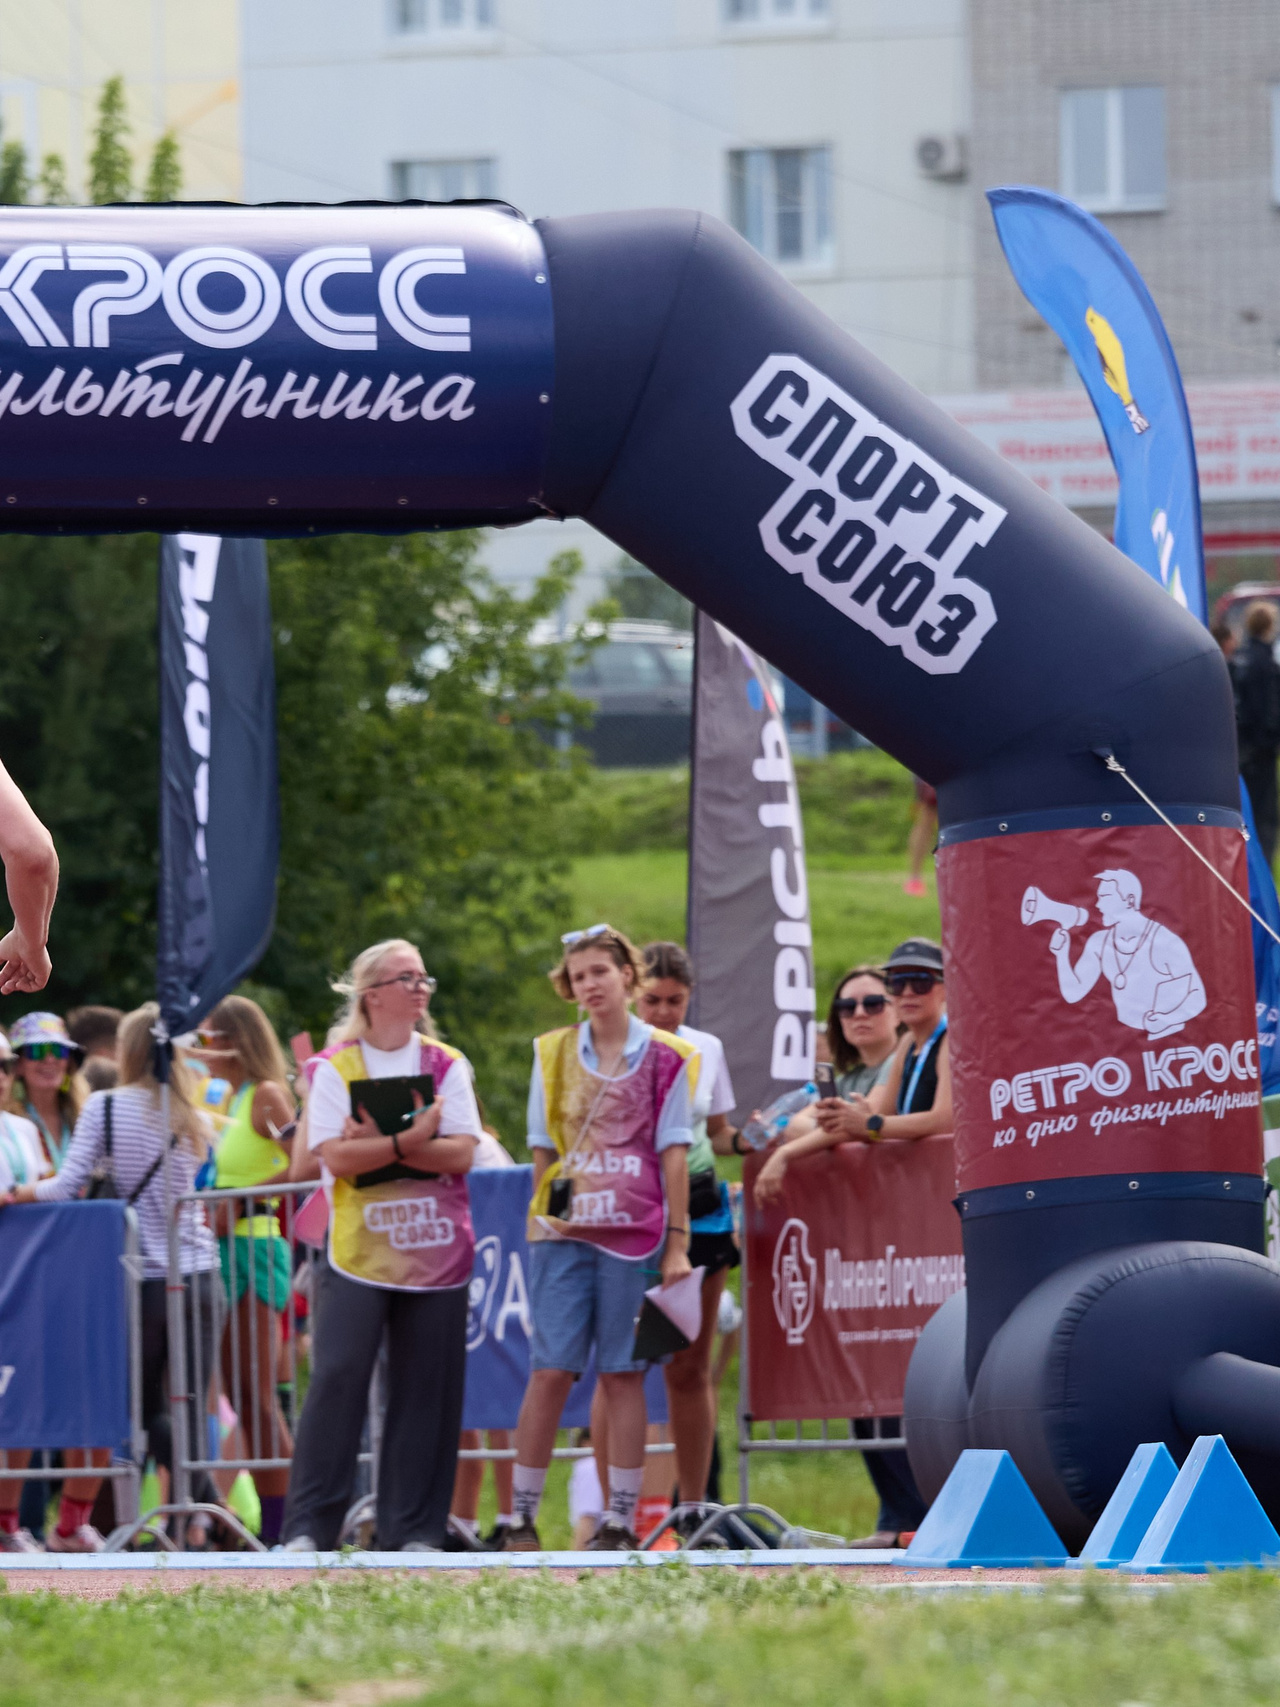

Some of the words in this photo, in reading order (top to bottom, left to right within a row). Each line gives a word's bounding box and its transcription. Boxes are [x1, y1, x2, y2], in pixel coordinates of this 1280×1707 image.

[748, 370, 986, 562] СПОРТ
[776, 488, 978, 657] СОЮЗ
[990, 1057, 1131, 1121] РЕТРО
[1142, 1039, 1258, 1092] КРОСС
[992, 1125, 1016, 1149] ко
[1026, 1112, 1078, 1148] дню
[368, 1201, 433, 1227] СПОРТ
[394, 1221, 460, 1245] СОЮЗ
